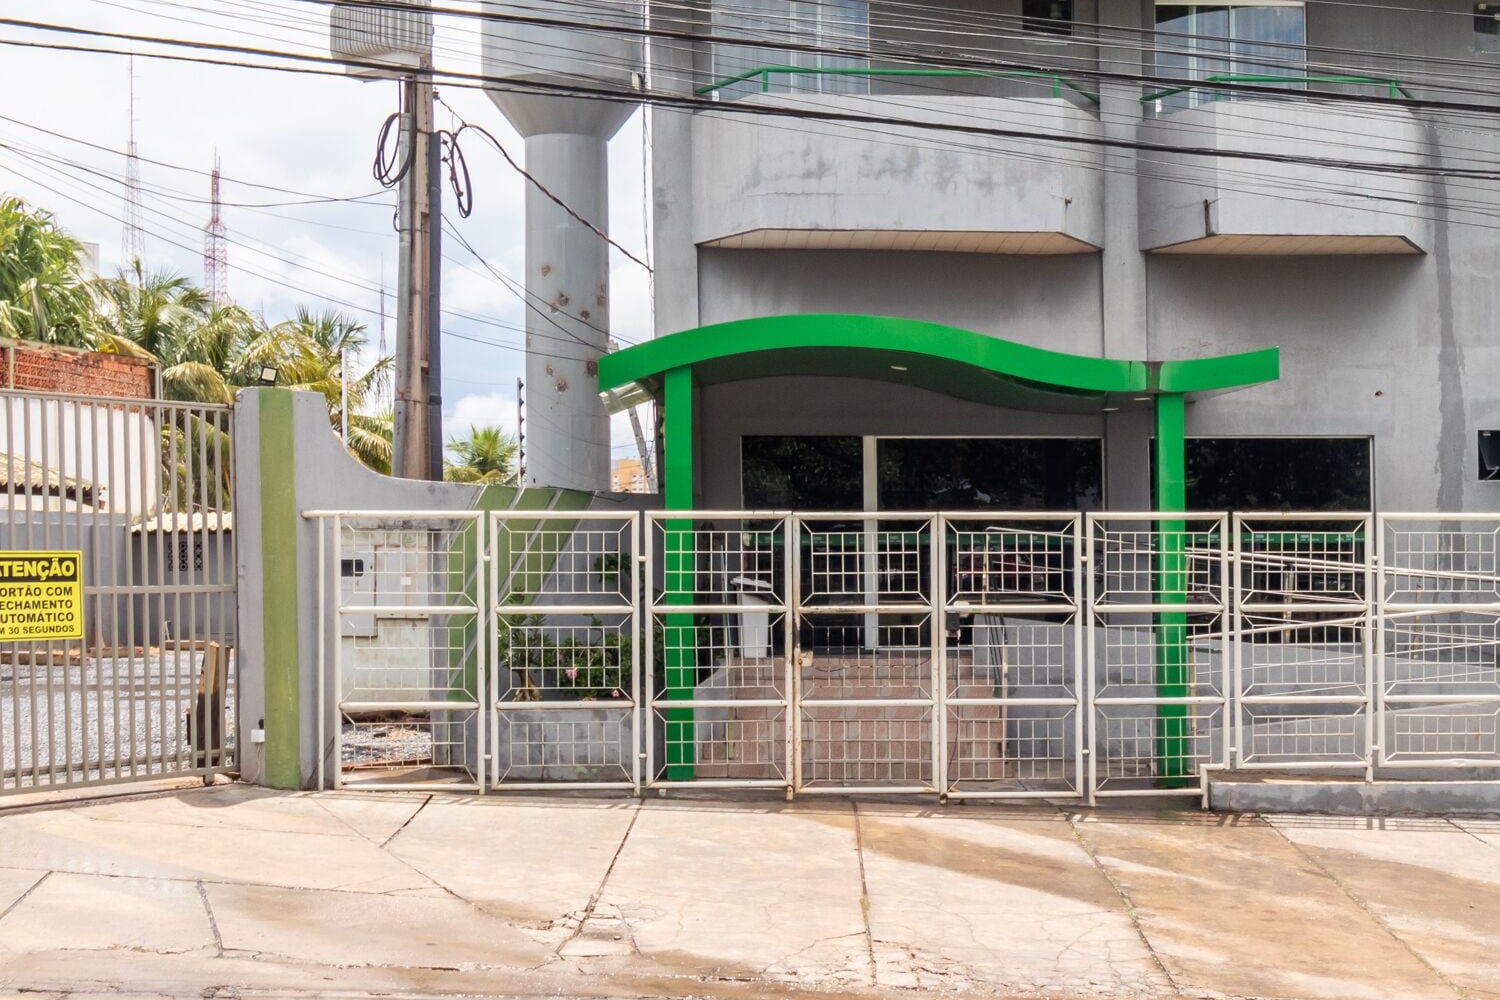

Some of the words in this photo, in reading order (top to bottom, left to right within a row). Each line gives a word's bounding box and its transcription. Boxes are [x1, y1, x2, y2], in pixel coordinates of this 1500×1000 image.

[0, 557, 75, 581] TENÇÃO
[0, 585, 42, 597] ORTÃO
[46, 586, 73, 596] COM
[0, 599, 73, 610] ECHAMENTO
[0, 611, 74, 624] UTOMÁTICO
[8, 626, 20, 635] 30
[22, 625, 75, 634] SEGUNDOS
